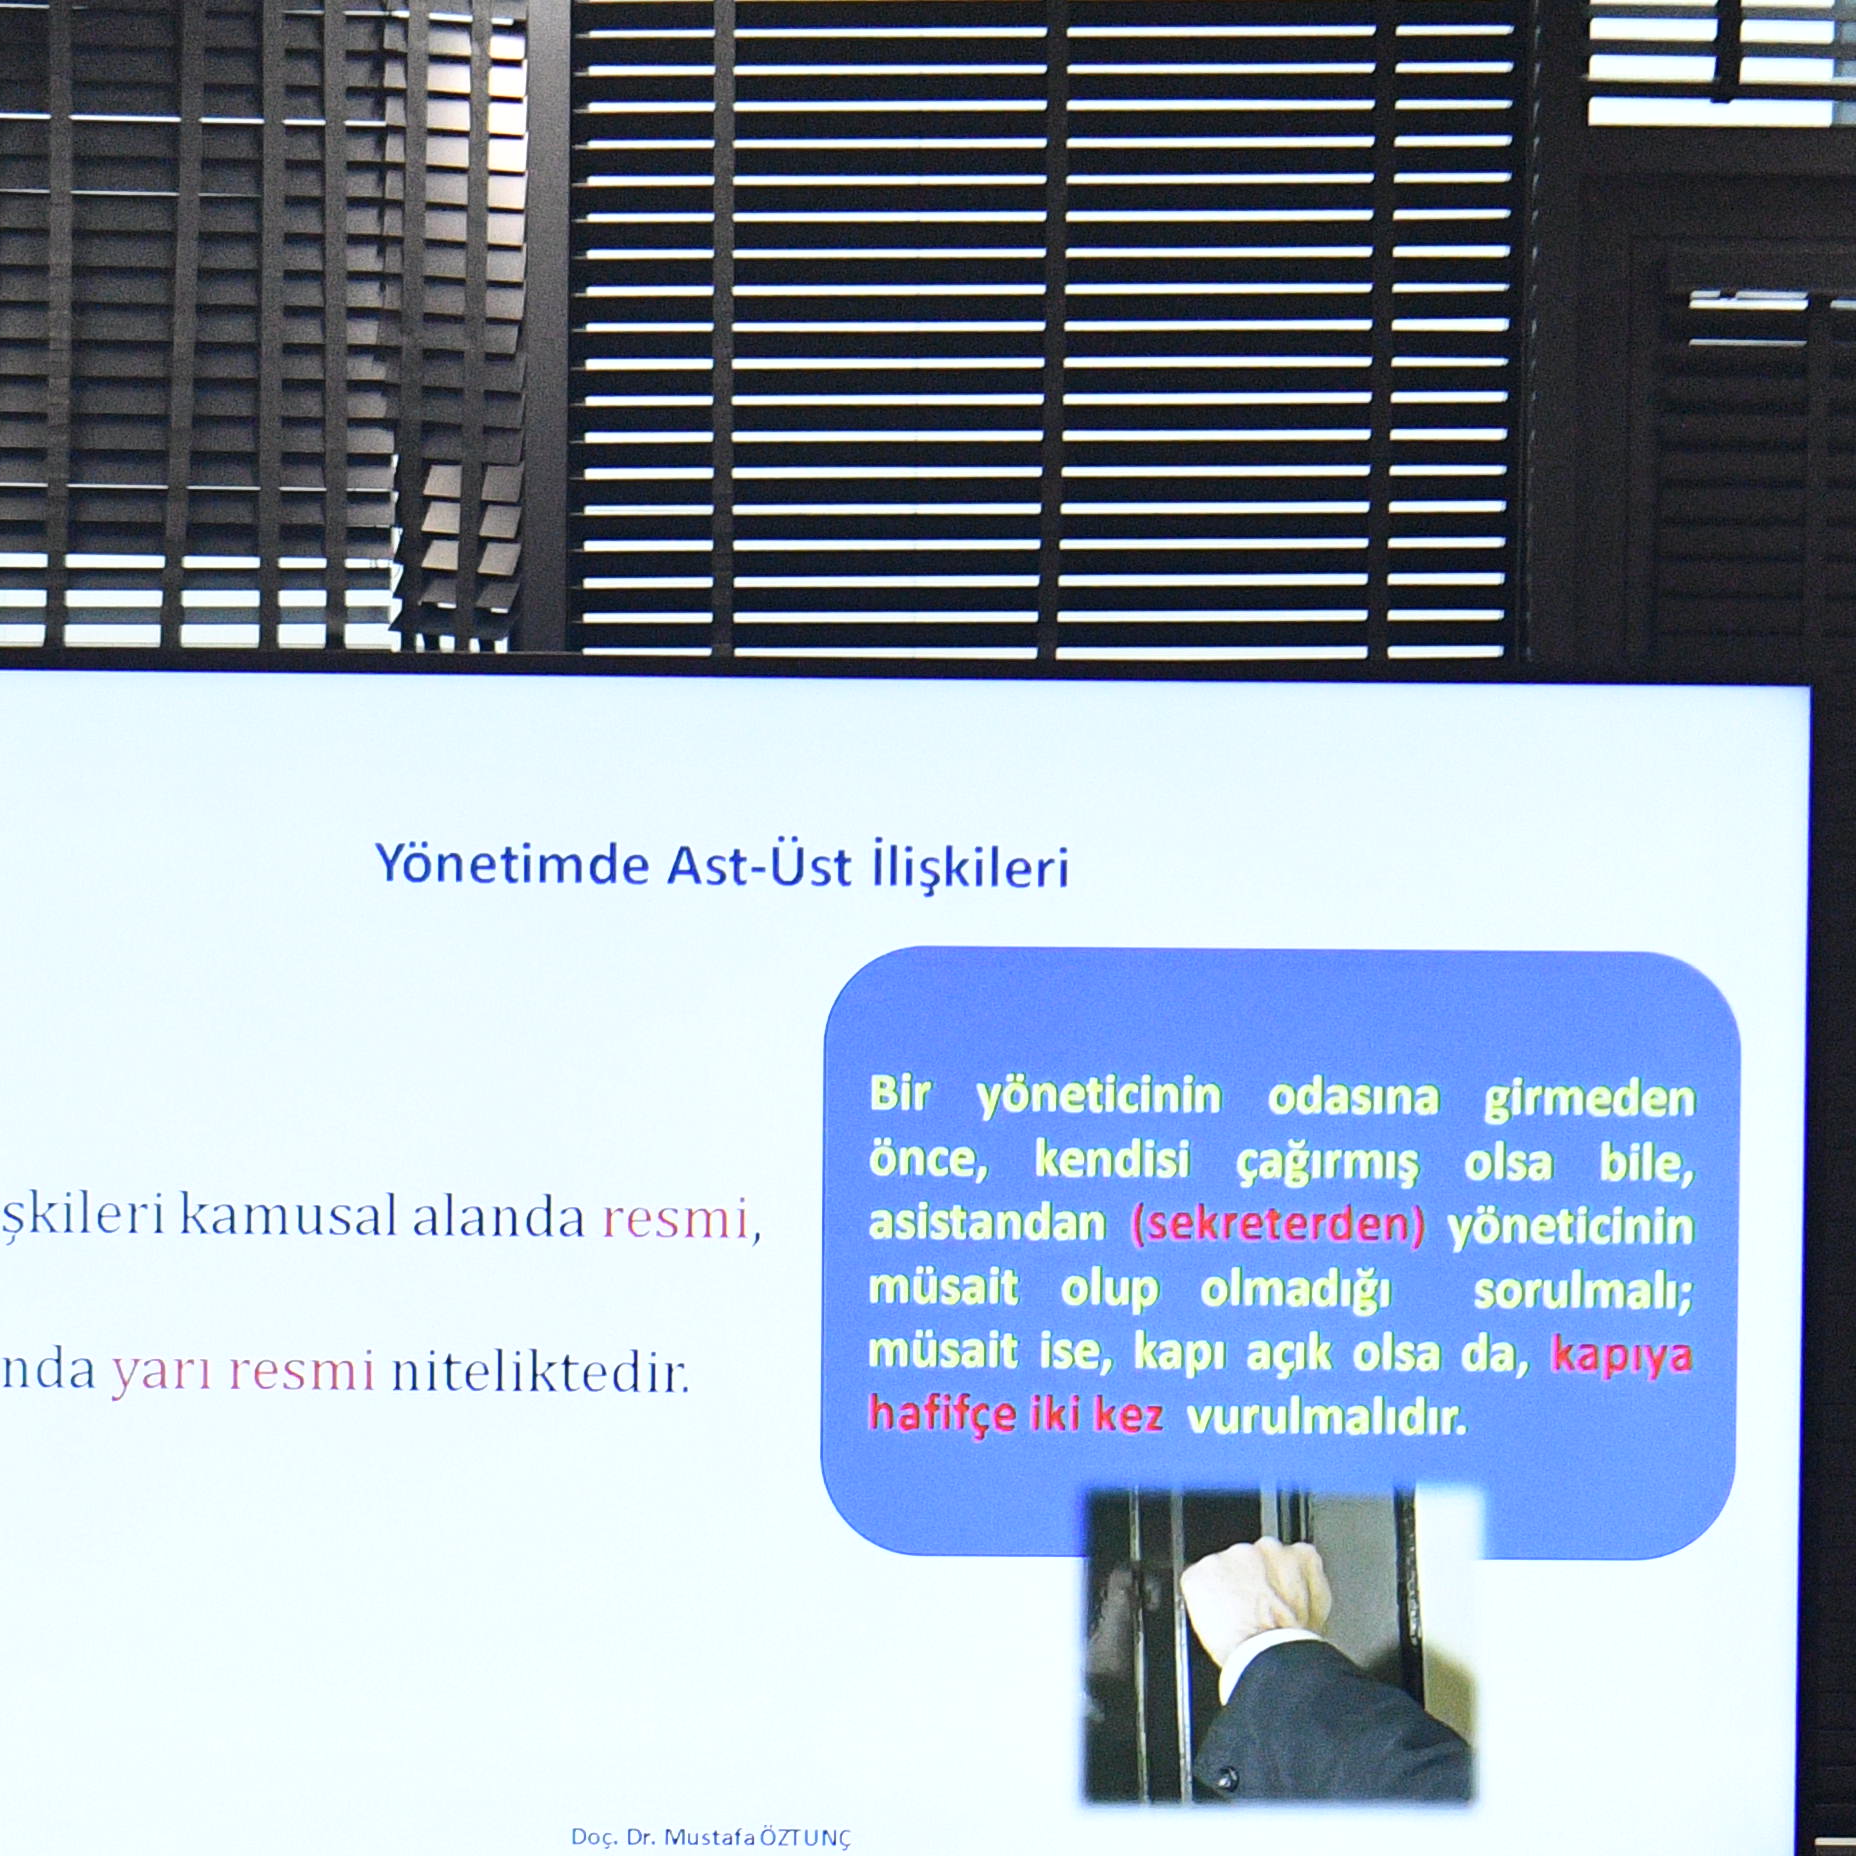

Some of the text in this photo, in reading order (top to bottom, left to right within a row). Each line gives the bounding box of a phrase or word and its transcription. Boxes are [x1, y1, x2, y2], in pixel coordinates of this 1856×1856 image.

[373, 834, 1069, 900] Yönetimde Ast-Üst İlişkileri
[870, 1070, 1698, 1124] Bir yöneticinin odasına girmeden
[868, 1136, 1697, 1191] önce, kendisi çağırmış olsa bile,
[178, 1188, 397, 1238] kamusal
[411, 1191, 586, 1239] alanda
[602, 1195, 762, 1248] resmi,
[868, 1200, 1697, 1254] asistandan (sekreterden) yöneticinin
[868, 1264, 1696, 1318] müsait olup olmadığı sorulmalı;
[110, 1356, 211, 1404] yarı
[229, 1348, 375, 1392] resmi
[391, 1346, 690, 1395] niteliktedir.
[868, 1328, 1695, 1383] müsait ise, kapı açık olsa da, kapıya
[866, 1391, 1467, 1445] hafifçe iki kez vurulmalıdır.
[570, 1823, 852, 1853] Doç. Dr. Mustafa ÖZTUNÇ
